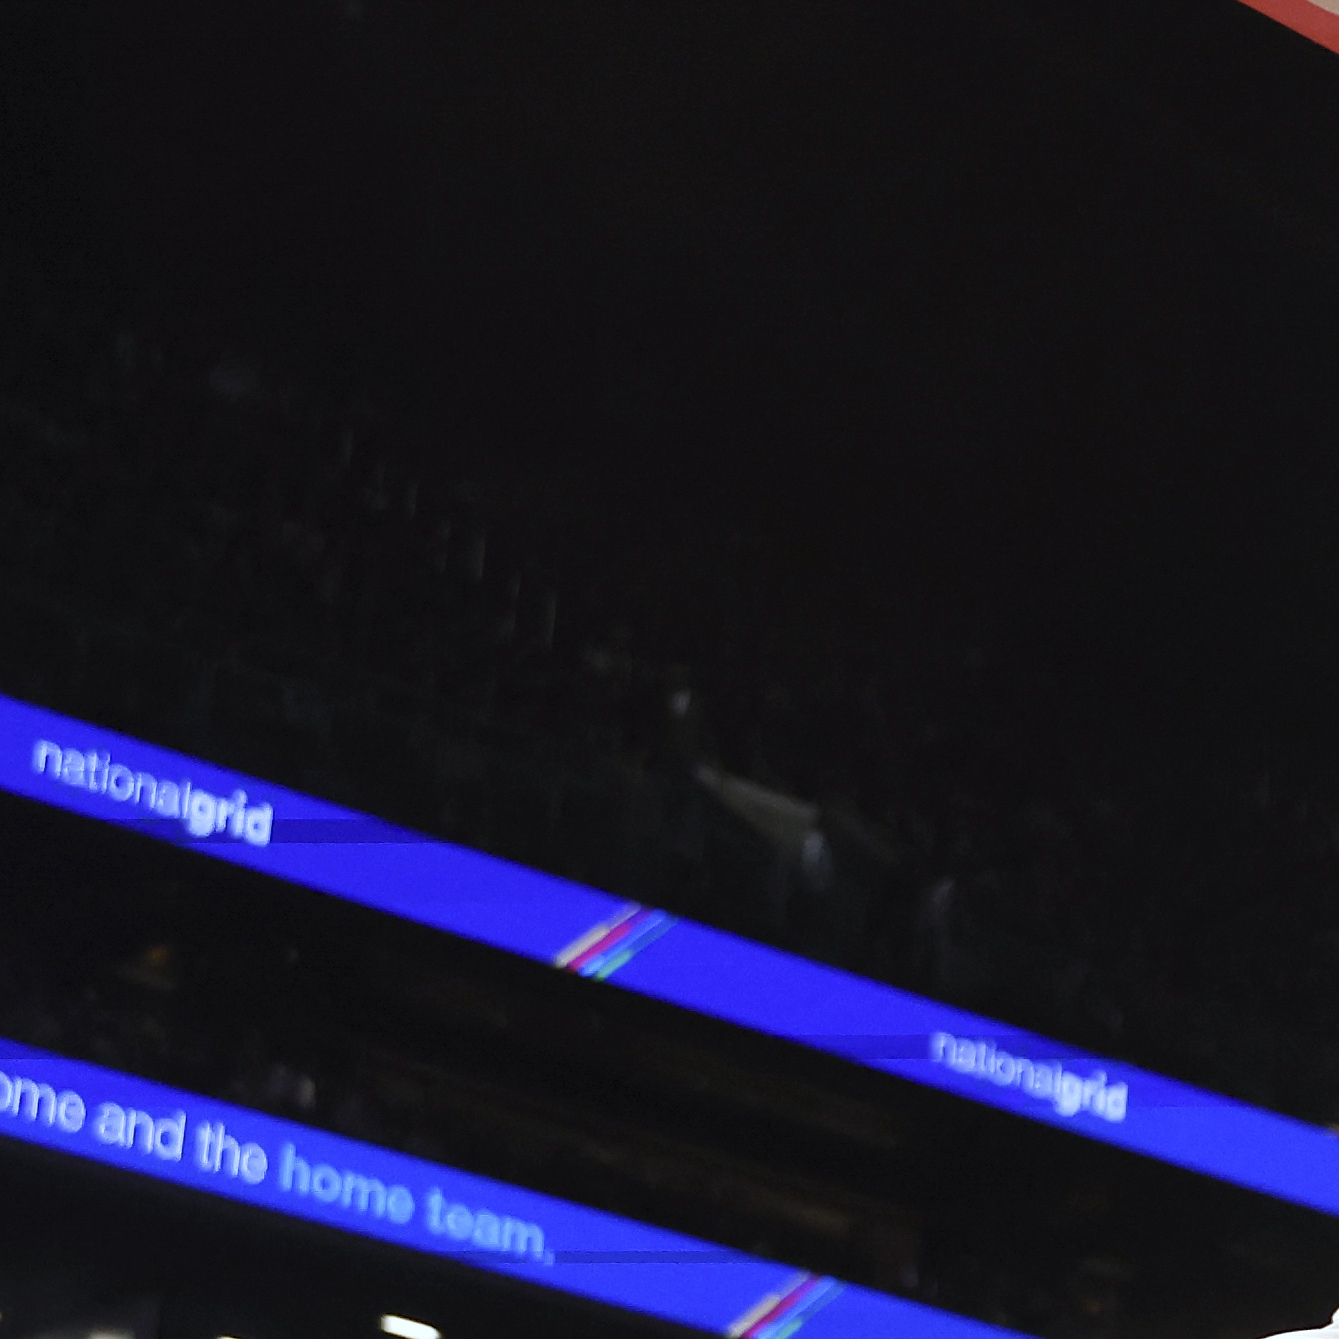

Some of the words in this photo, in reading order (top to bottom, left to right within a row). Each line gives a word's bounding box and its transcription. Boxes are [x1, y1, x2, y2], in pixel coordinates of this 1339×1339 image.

[33, 738, 274, 847] nationalgrid
[97, 1102, 188, 1162] and
[198, 1121, 269, 1185] the
[280, 1141, 416, 1224] home
